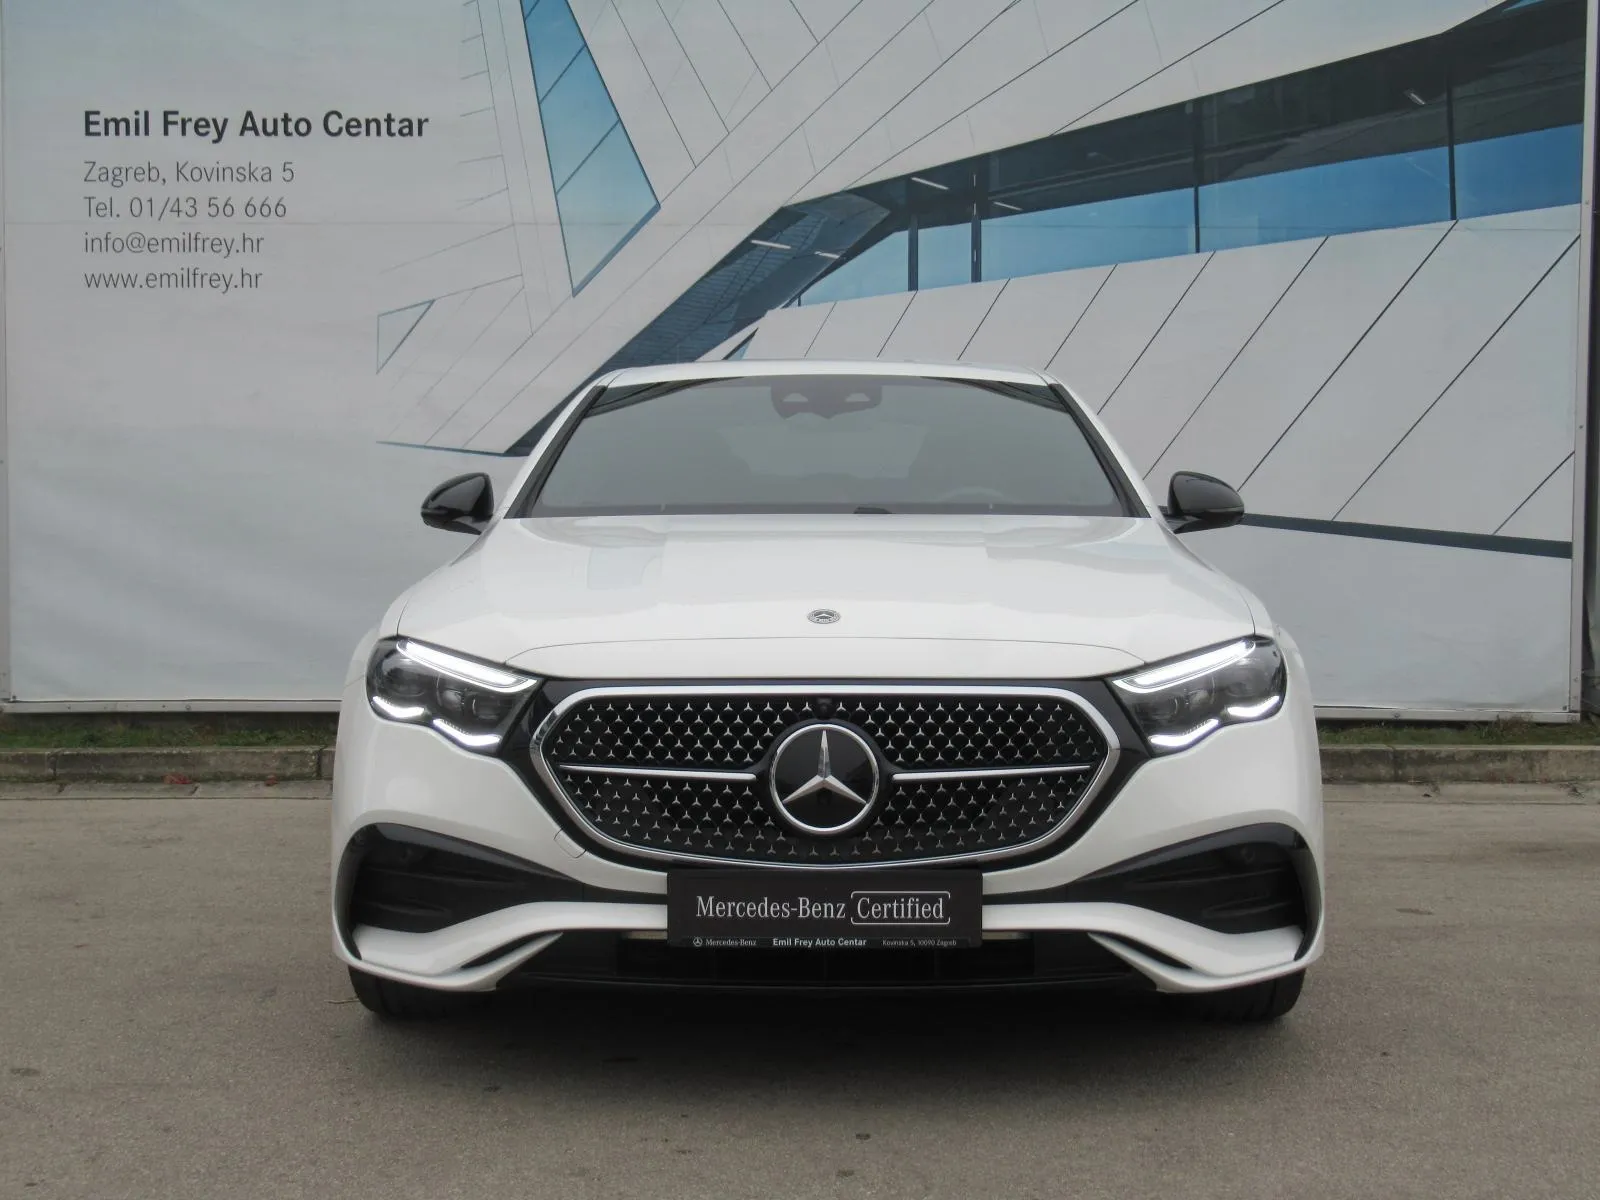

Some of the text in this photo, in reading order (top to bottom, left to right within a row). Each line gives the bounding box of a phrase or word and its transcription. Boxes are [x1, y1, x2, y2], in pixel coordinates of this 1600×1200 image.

[84, 110, 429, 143] Emil Frey Auto Centar
[84, 161, 294, 188] Zagreb, Kovinska 5
[84, 196, 287, 221] Tel. 01/43 56 666
[84, 232, 264, 259] info@emilfrey.hr
[84, 267, 263, 294] www.emilfrey.hr
[696, 896, 944, 919] Mercedes-Benz Certified
[705, 938, 757, 947] Mercedes-Benz
[772, 938, 867, 948] Emil Frey Auto Centar
